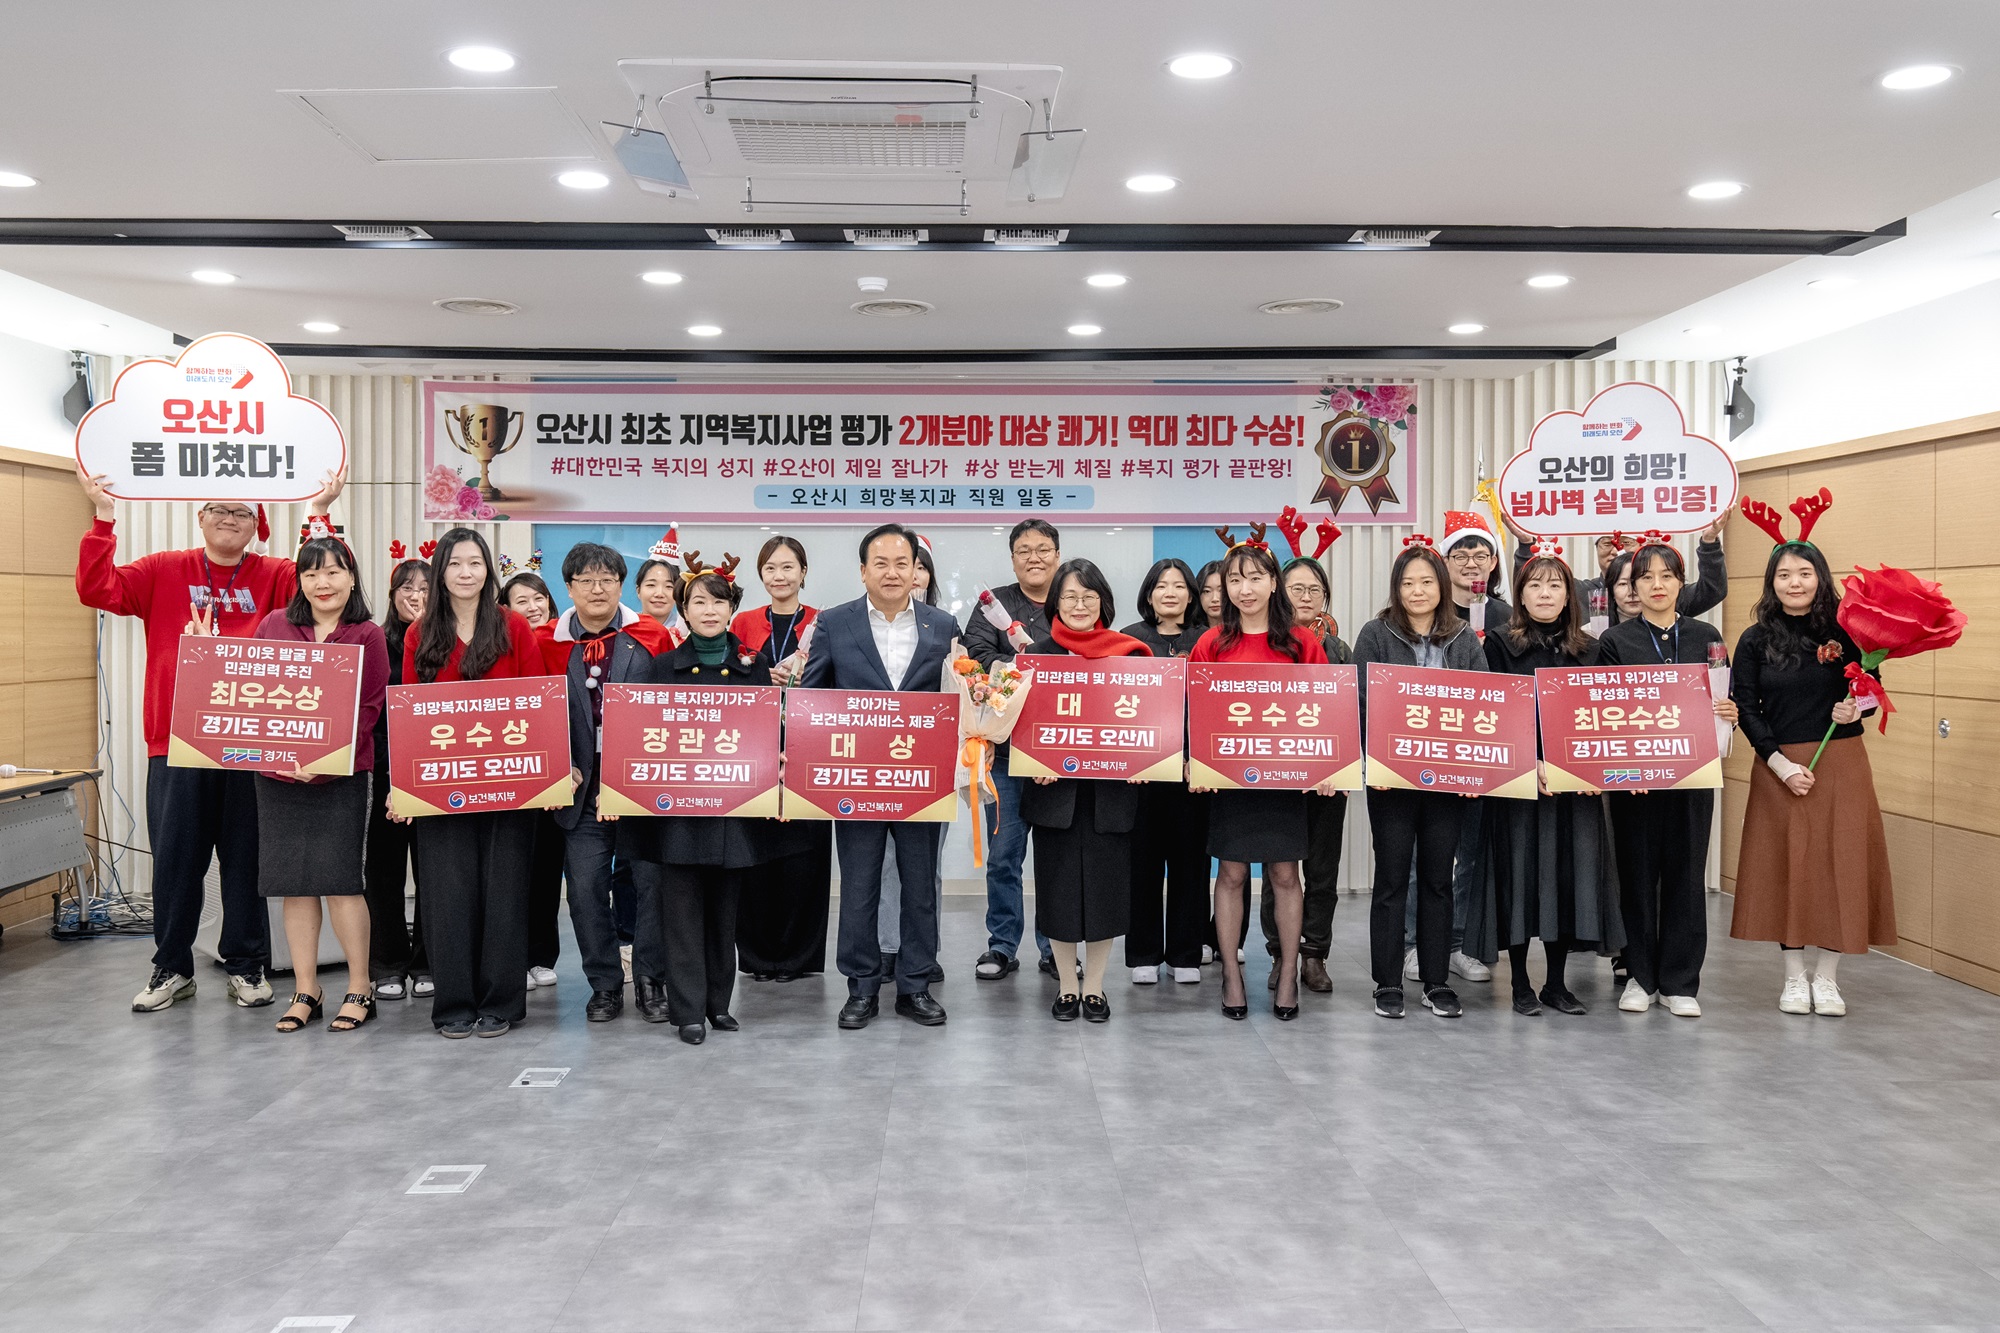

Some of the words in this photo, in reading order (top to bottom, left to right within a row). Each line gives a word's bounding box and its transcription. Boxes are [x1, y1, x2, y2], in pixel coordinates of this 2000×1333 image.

[218, 368, 232, 376] 변화
[162, 399, 264, 434] 오산시
[537, 414, 611, 444] 오산시
[621, 413, 671, 444] 최초
[680, 415, 831, 445] 지역복지사업
[841, 415, 892, 445] 평가
[899, 415, 993, 446] 2개분야
[1000, 415, 1051, 446] 대상
[1058, 416, 1118, 447] 쾌거!
[1128, 416, 1178, 446] 역대
[1186, 414, 1237, 446] 최다
[1244, 415, 1304, 446] 수상!
[131, 442, 165, 476] 폼
[179, 442, 294, 479] 미쳤다!
[551, 457, 642, 477] #대한민국
[652, 458, 707, 477] 복지의
[717, 458, 752, 478] 성지
[764, 459, 834, 477] #오산이
[845, 459, 881, 478] 제일
[892, 459, 948, 478] 잘나가
[965, 459, 999, 478] #상
[1009, 459, 1063, 478] 받는게
[1075, 459, 1110, 478] 체질
[1121, 459, 1172, 478] #복지
[1183, 459, 1219, 478] 평가
[1229, 459, 1291, 478] 끝판왕!
[1539, 456, 1613, 483] 오산의
[1624, 453, 1686, 480] 희망!
[791, 489, 846, 506] 오산시
[860, 489, 956, 506] 희망복지과
[969, 489, 1003, 506] 직원
[1018, 489, 1053, 506] 일동
[1511, 490, 1584, 517] 넘사벽
[1594, 488, 1643, 514] 실력
[1654, 486, 1717, 513] 인증!
[654, 540, 680, 550] Merry
[195, 594, 209, 602] SAN
[215, 644, 242, 658] 위기
[248, 646, 274, 659] 이웃
[280, 648, 306, 661] 발굴
[312, 650, 324, 662] 및
[225, 662, 280, 677] 민관협력
[285, 665, 312, 678] 추진
[1568, 673, 1620, 685] 긴급복지
[1625, 671, 1678, 684] 위기상담
[1037, 672, 1088, 684] 민관협력
[1093, 673, 1105, 684] 및
[1110, 673, 1162, 686] 자원연계
[1209, 680, 1281, 693] 사회보장급여
[1286, 681, 1309, 693] 사후
[1313, 682, 1337, 694] 관리
[210, 681, 322, 710] 최우수상
[626, 689, 669, 704] 겨울철
[674, 692, 758, 706] 복지위기가구
[1398, 682, 1476, 700] 기초생활보장
[1480, 690, 1504, 702] 사업
[1589, 688, 1629, 700] 활성화
[1634, 687, 1660, 699] 추진
[413, 698, 510, 715] 희망복지지원단
[515, 695, 541, 709] 운영
[847, 697, 900, 710] 찾아가는
[810, 713, 904, 727] 보건복지서비스
[909, 716, 935, 728] 제공
[1575, 705, 1681, 730] 최우수상
[203, 716, 259, 735] 경기도
[267, 720, 324, 739] 오산시
[1040, 728, 1092, 744] 경기도
[1100, 730, 1154, 747] 오산시
[1218, 738, 1272, 754] 경기도
[1279, 739, 1332, 755] 오산시
[1395, 736, 1451, 758] 경기도
[1455, 744, 1509, 764] 오산시
[1572, 740, 1628, 757] 경기도
[1634, 739, 1690, 755] 오산시
[264, 750, 297, 762] 경기도
[420, 757, 477, 780] 경기도
[482, 753, 541, 776] 오산시
[631, 763, 686, 780] 경기도
[695, 764, 749, 781] 오산시
[1082, 761, 1127, 771] 보건복지부
[1643, 769, 1676, 780] 경기도
[814, 768, 867, 785] 경기도
[875, 770, 929, 787] 오산시
[1264, 771, 1308, 780] 보건복지부
[1439, 775, 1483, 786] 보건복지부
[469, 792, 516, 803] 보건복지부
[676, 798, 722, 807] 보건복지부
[858, 802, 902, 812] 보건복지부
